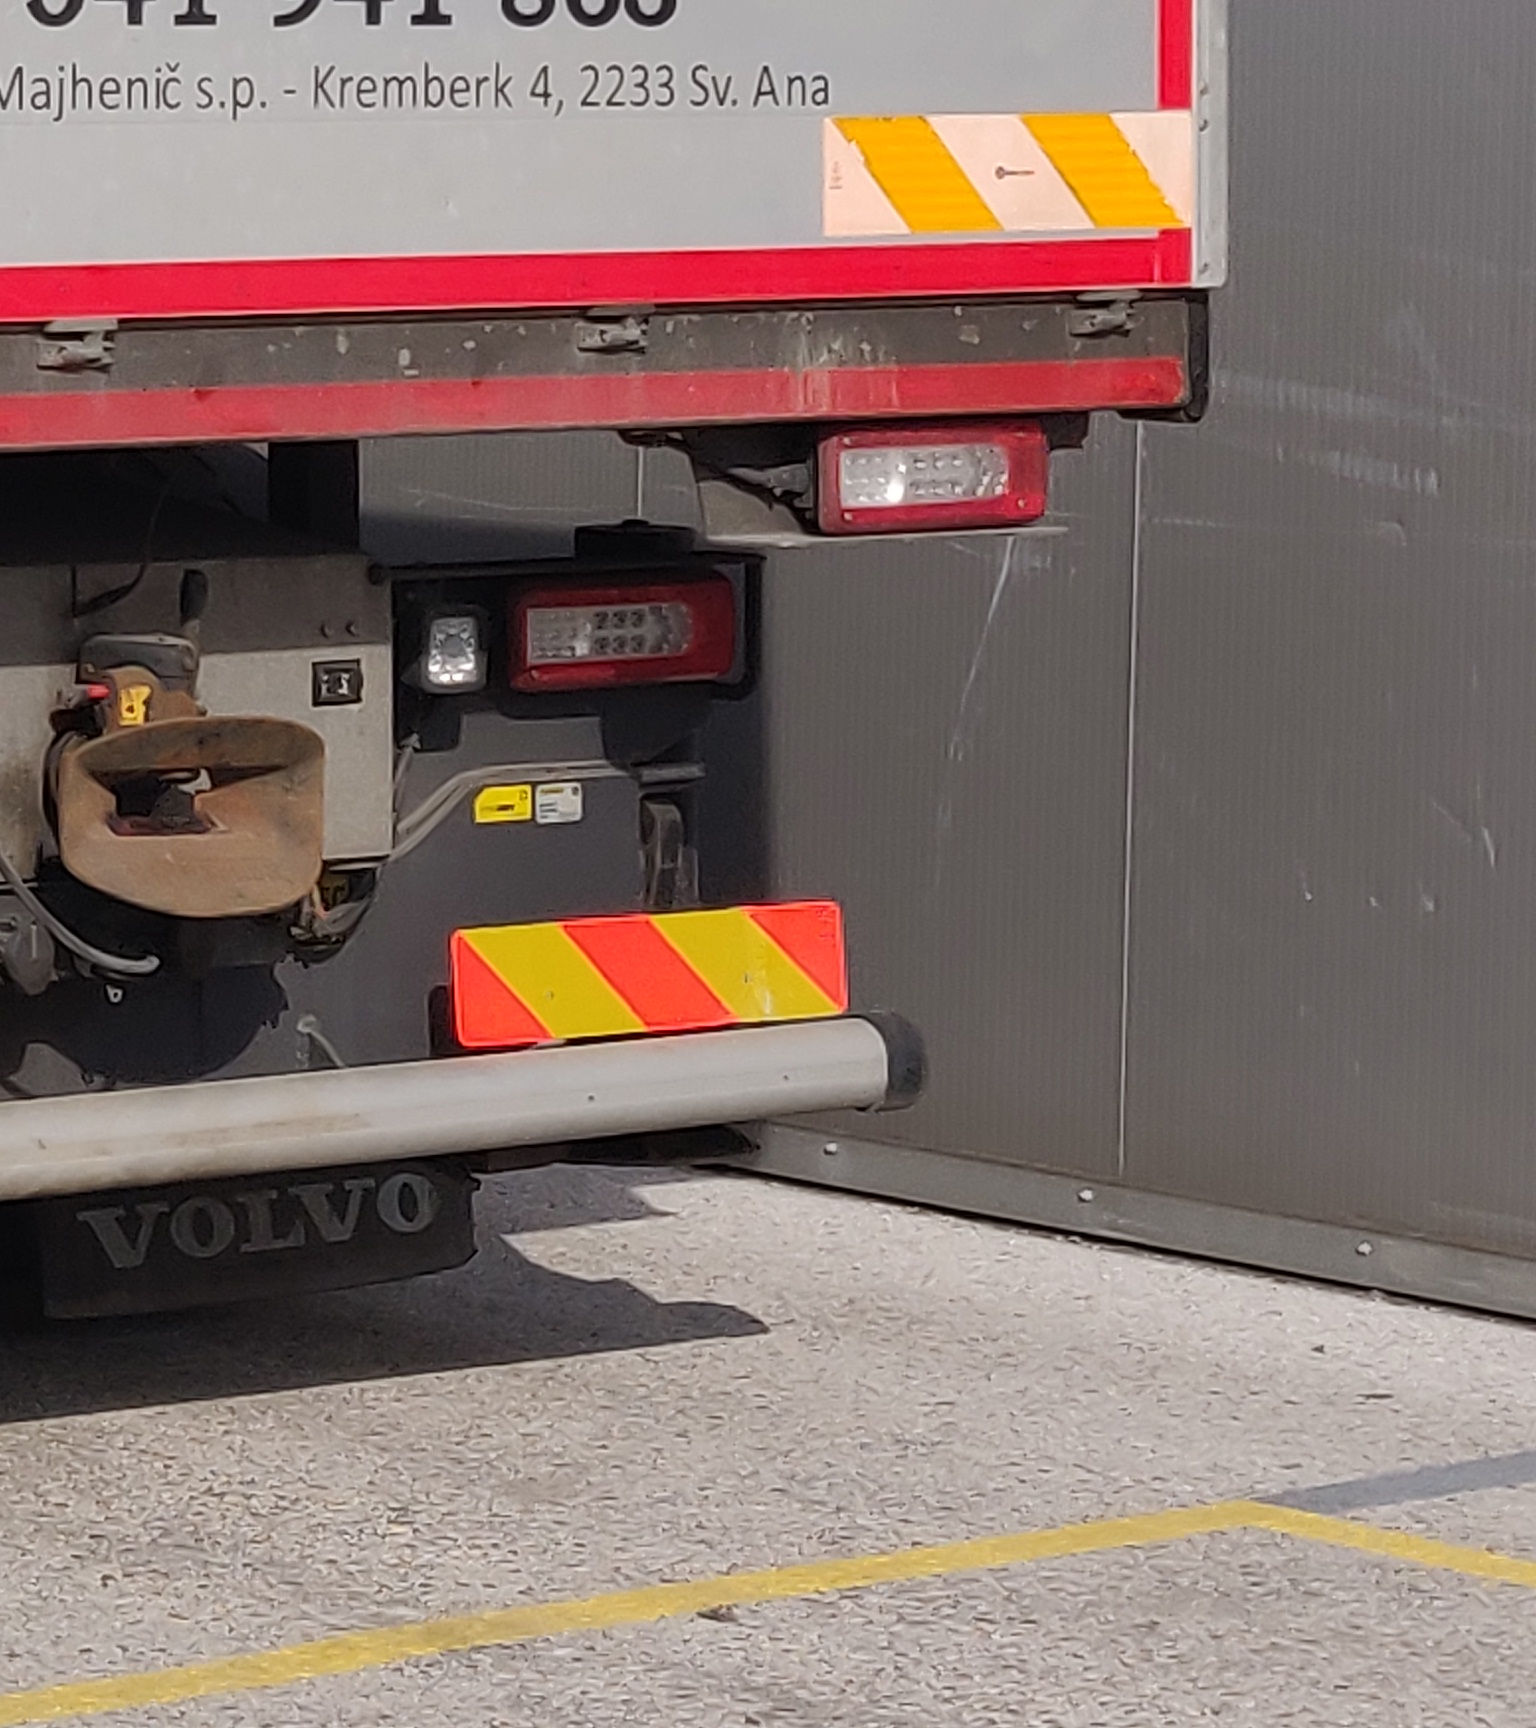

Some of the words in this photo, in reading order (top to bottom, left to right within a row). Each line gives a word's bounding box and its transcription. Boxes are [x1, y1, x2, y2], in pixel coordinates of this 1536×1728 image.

[195, 76, 268, 120] s.p.
[313, 64, 512, 113] Kremberk
[529, 68, 565, 120] 4,
[580, 65, 676, 110] 2233
[689, 65, 739, 108] Sv.
[751, 65, 831, 110] Ana
[77, 1173, 438, 1270] VOLVO
